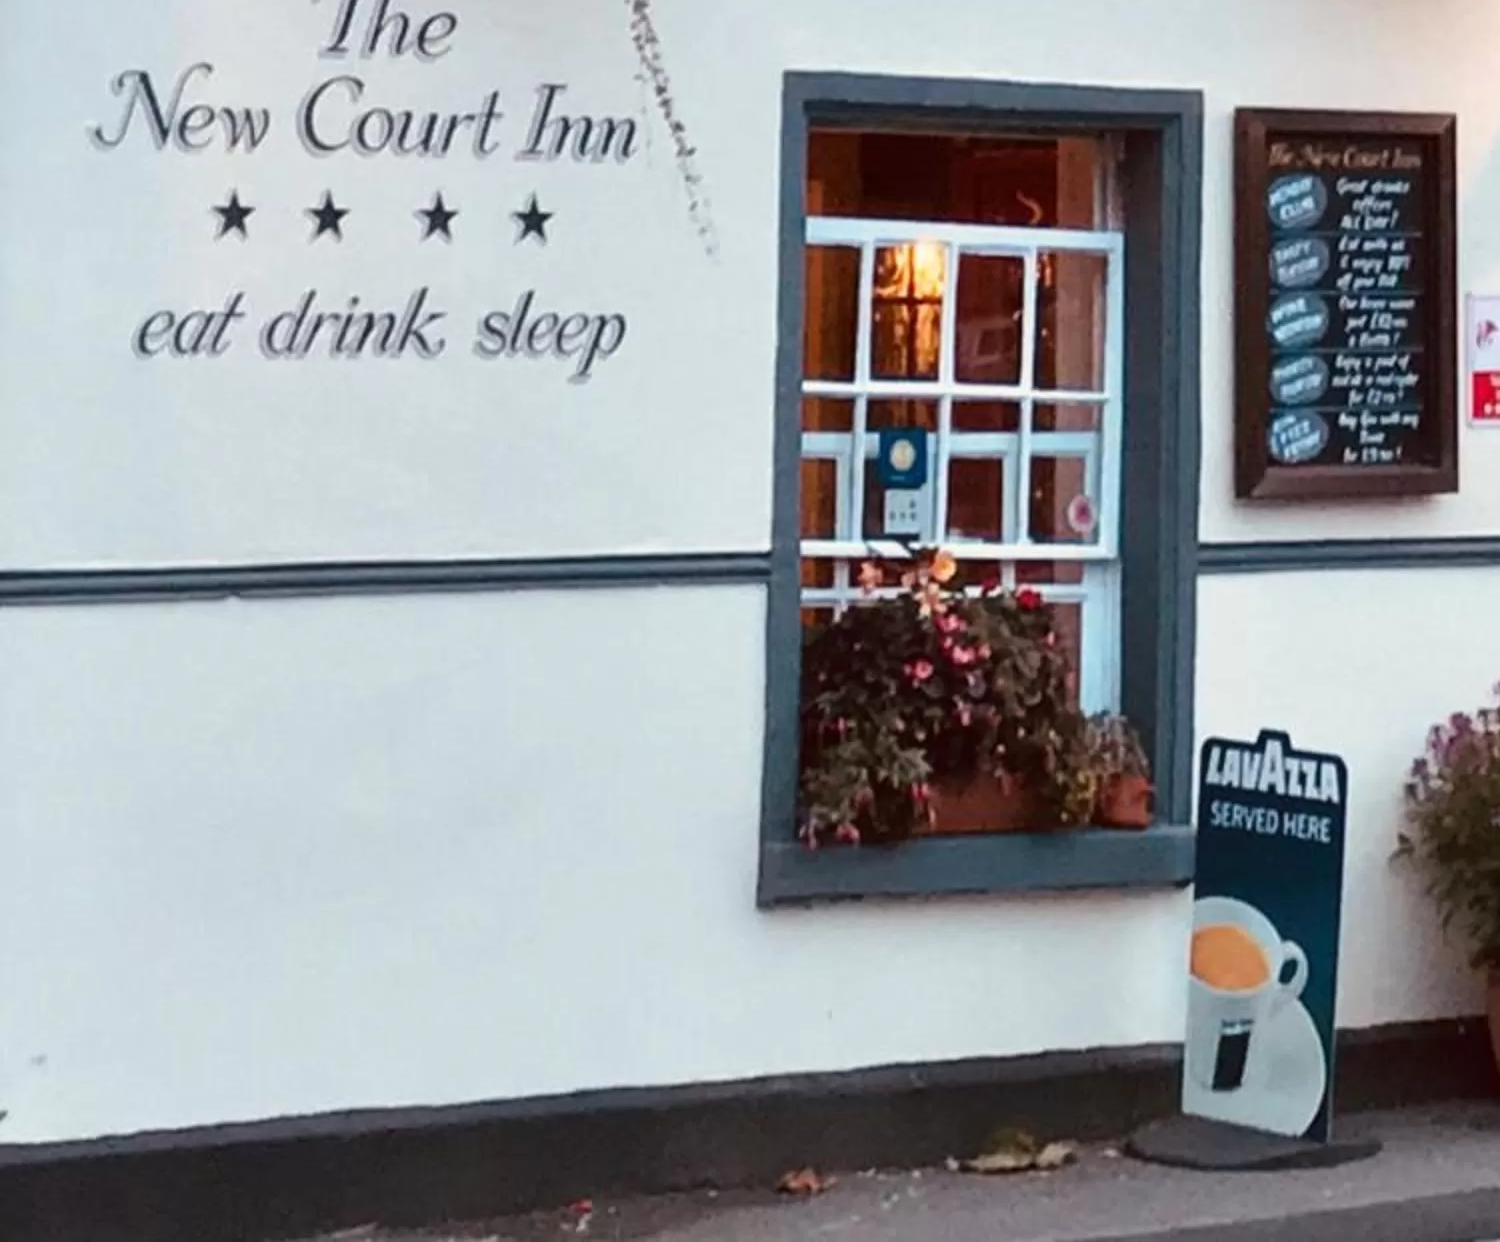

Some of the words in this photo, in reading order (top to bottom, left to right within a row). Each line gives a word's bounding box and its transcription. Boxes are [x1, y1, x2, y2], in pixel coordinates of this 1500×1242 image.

[90, 63, 269, 152] New
[298, 76, 502, 158] Court
[515, 84, 637, 160] Inn
[1343, 146, 1389, 168] Court
[133, 291, 246, 360] eat
[260, 288, 446, 360] drink
[474, 291, 627, 384] sleep
[1205, 739, 1340, 805] LAVAZZA
[1211, 799, 1279, 835] SERVED
[1283, 811, 1332, 844] HERE
